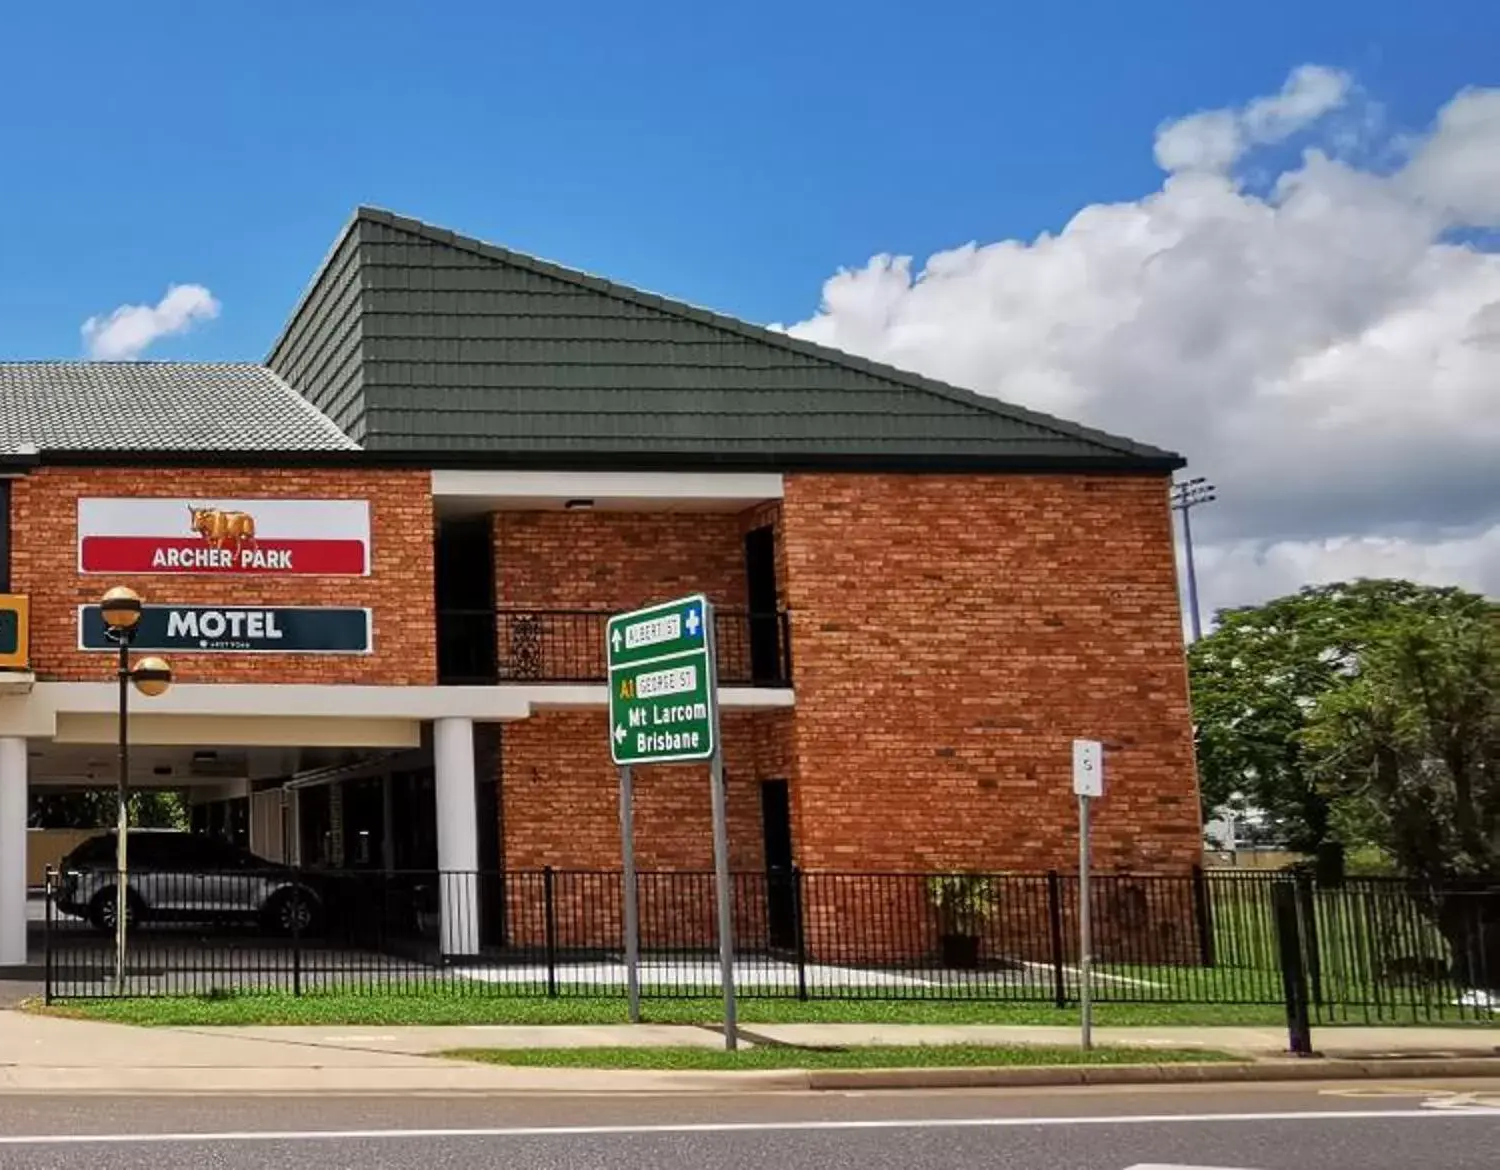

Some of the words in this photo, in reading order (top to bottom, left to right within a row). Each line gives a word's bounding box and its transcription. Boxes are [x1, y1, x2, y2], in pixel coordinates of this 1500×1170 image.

[152, 548, 233, 568] ARCHER
[241, 549, 293, 569] PARK
[167, 611, 283, 638] MOTEL
[628, 622, 661, 644] ALBERT
[667, 619, 678, 635] ST
[620, 679, 634, 699] A1
[639, 673, 675, 693] GEORGE
[680, 671, 691, 688] ST
[628, 707, 647, 727] Mt
[654, 703, 706, 725] Larcom
[637, 732, 699, 752] Brisbane
